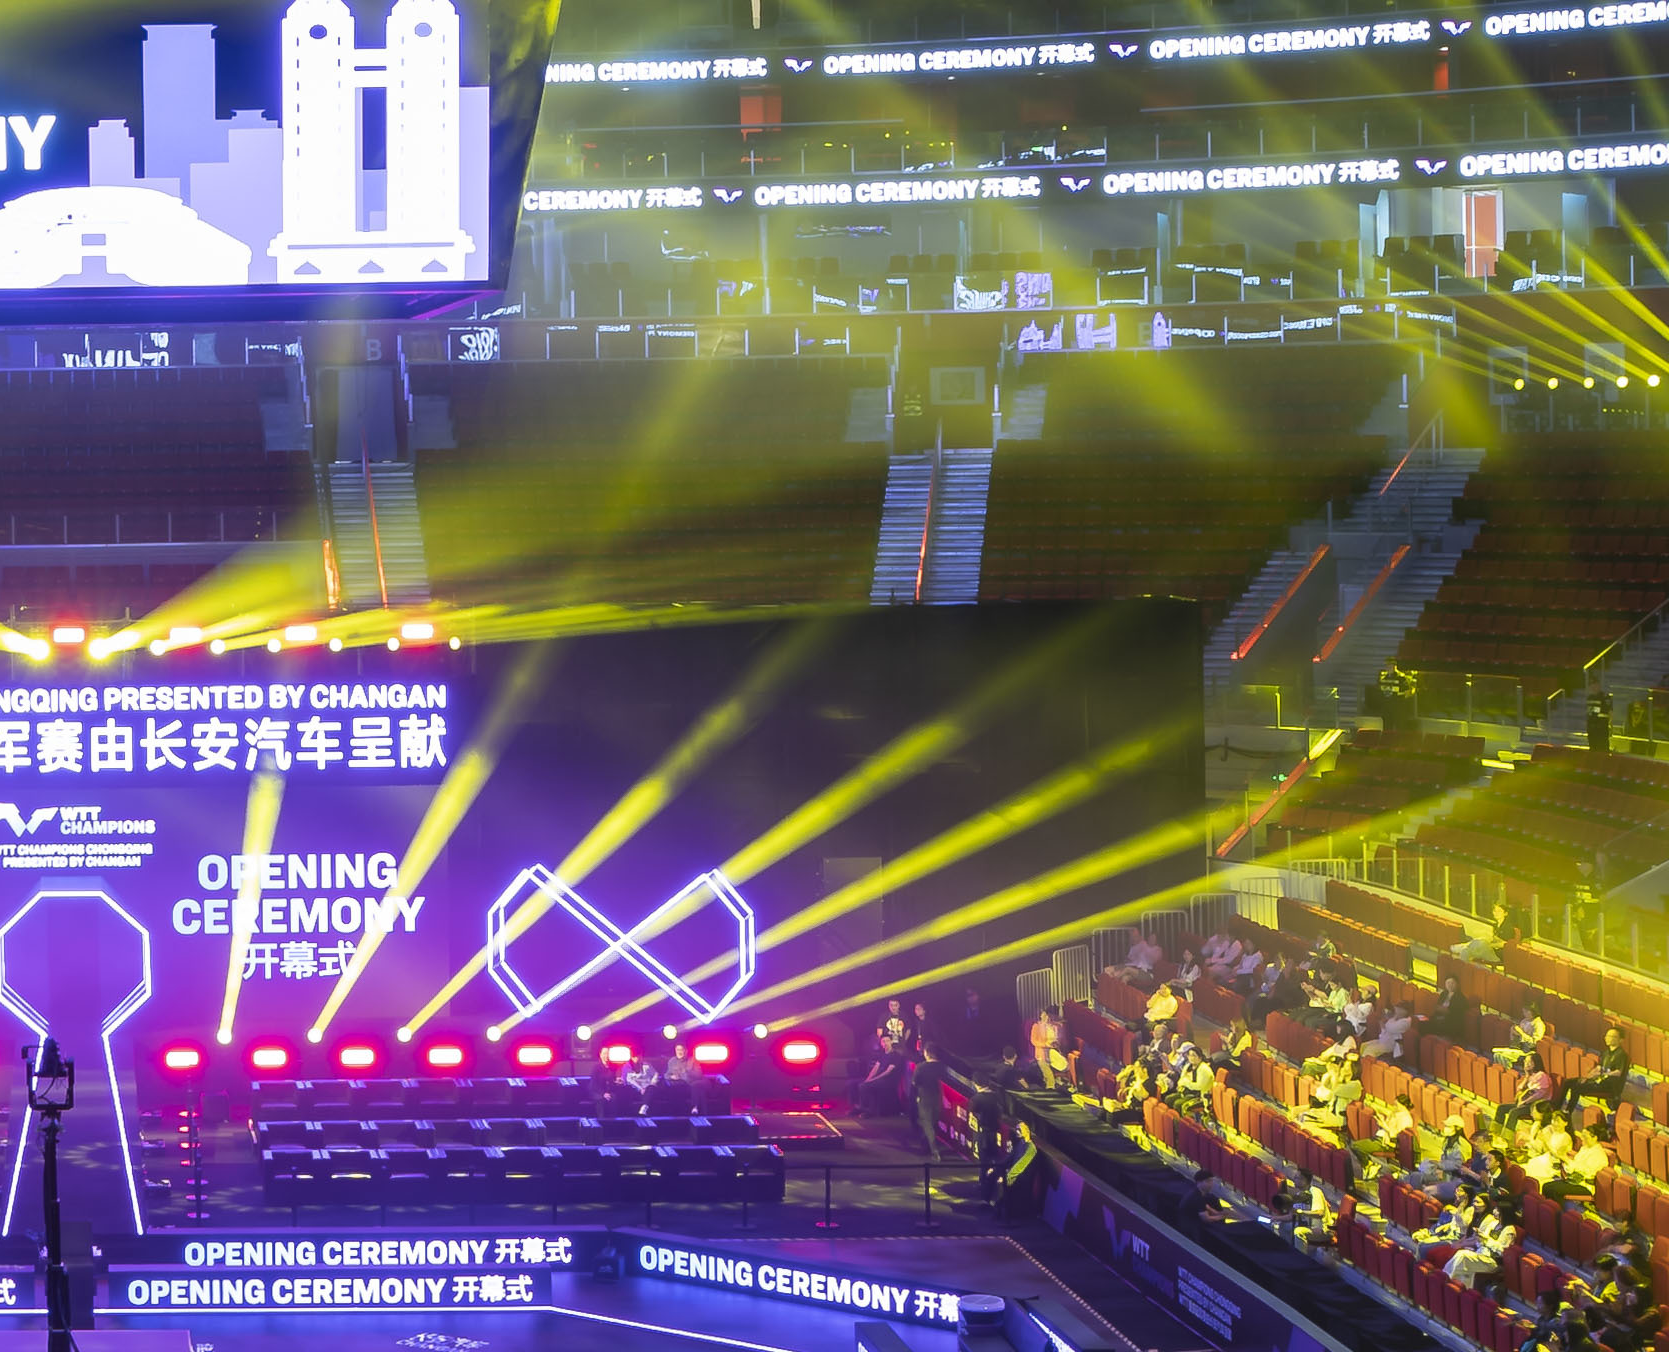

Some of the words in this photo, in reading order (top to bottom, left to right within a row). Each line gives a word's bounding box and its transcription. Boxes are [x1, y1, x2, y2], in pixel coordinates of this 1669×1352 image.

[1485, 8, 1586, 36] OPENING
[597, 60, 712, 82] CEREMONY
[823, 52, 916, 75] OPENING
[918, 46, 1037, 71] CEREMONY
[1460, 150, 1565, 177] OPENING
[522, 188, 644, 211] CEREMONY
[754, 183, 853, 206] OPENING
[854, 178, 981, 204] CEREMONY
[104, 685, 264, 712] PRESENTED
[269, 684, 306, 710] BY
[310, 682, 448, 710] CHANGAN
[59, 806, 102, 821] WTT
[60, 819, 156, 836] CHAMPIONS
[197, 852, 399, 892] OPENING
[172, 896, 426, 936] CEREMONY
[241, 940, 357, 981] 开幕式
[184, 1241, 316, 1266] OPENING
[322, 1239, 489, 1265] CEREMONY
[494, 1236, 573, 1264] 开幕式
[127, 1279, 265, 1305] OPENING
[271, 1277, 446, 1305] CEREMONY
[451, 1274, 534, 1303] 开幕式
[639, 1245, 753, 1287] OPENING
[757, 1264, 910, 1314] CEREMONY
